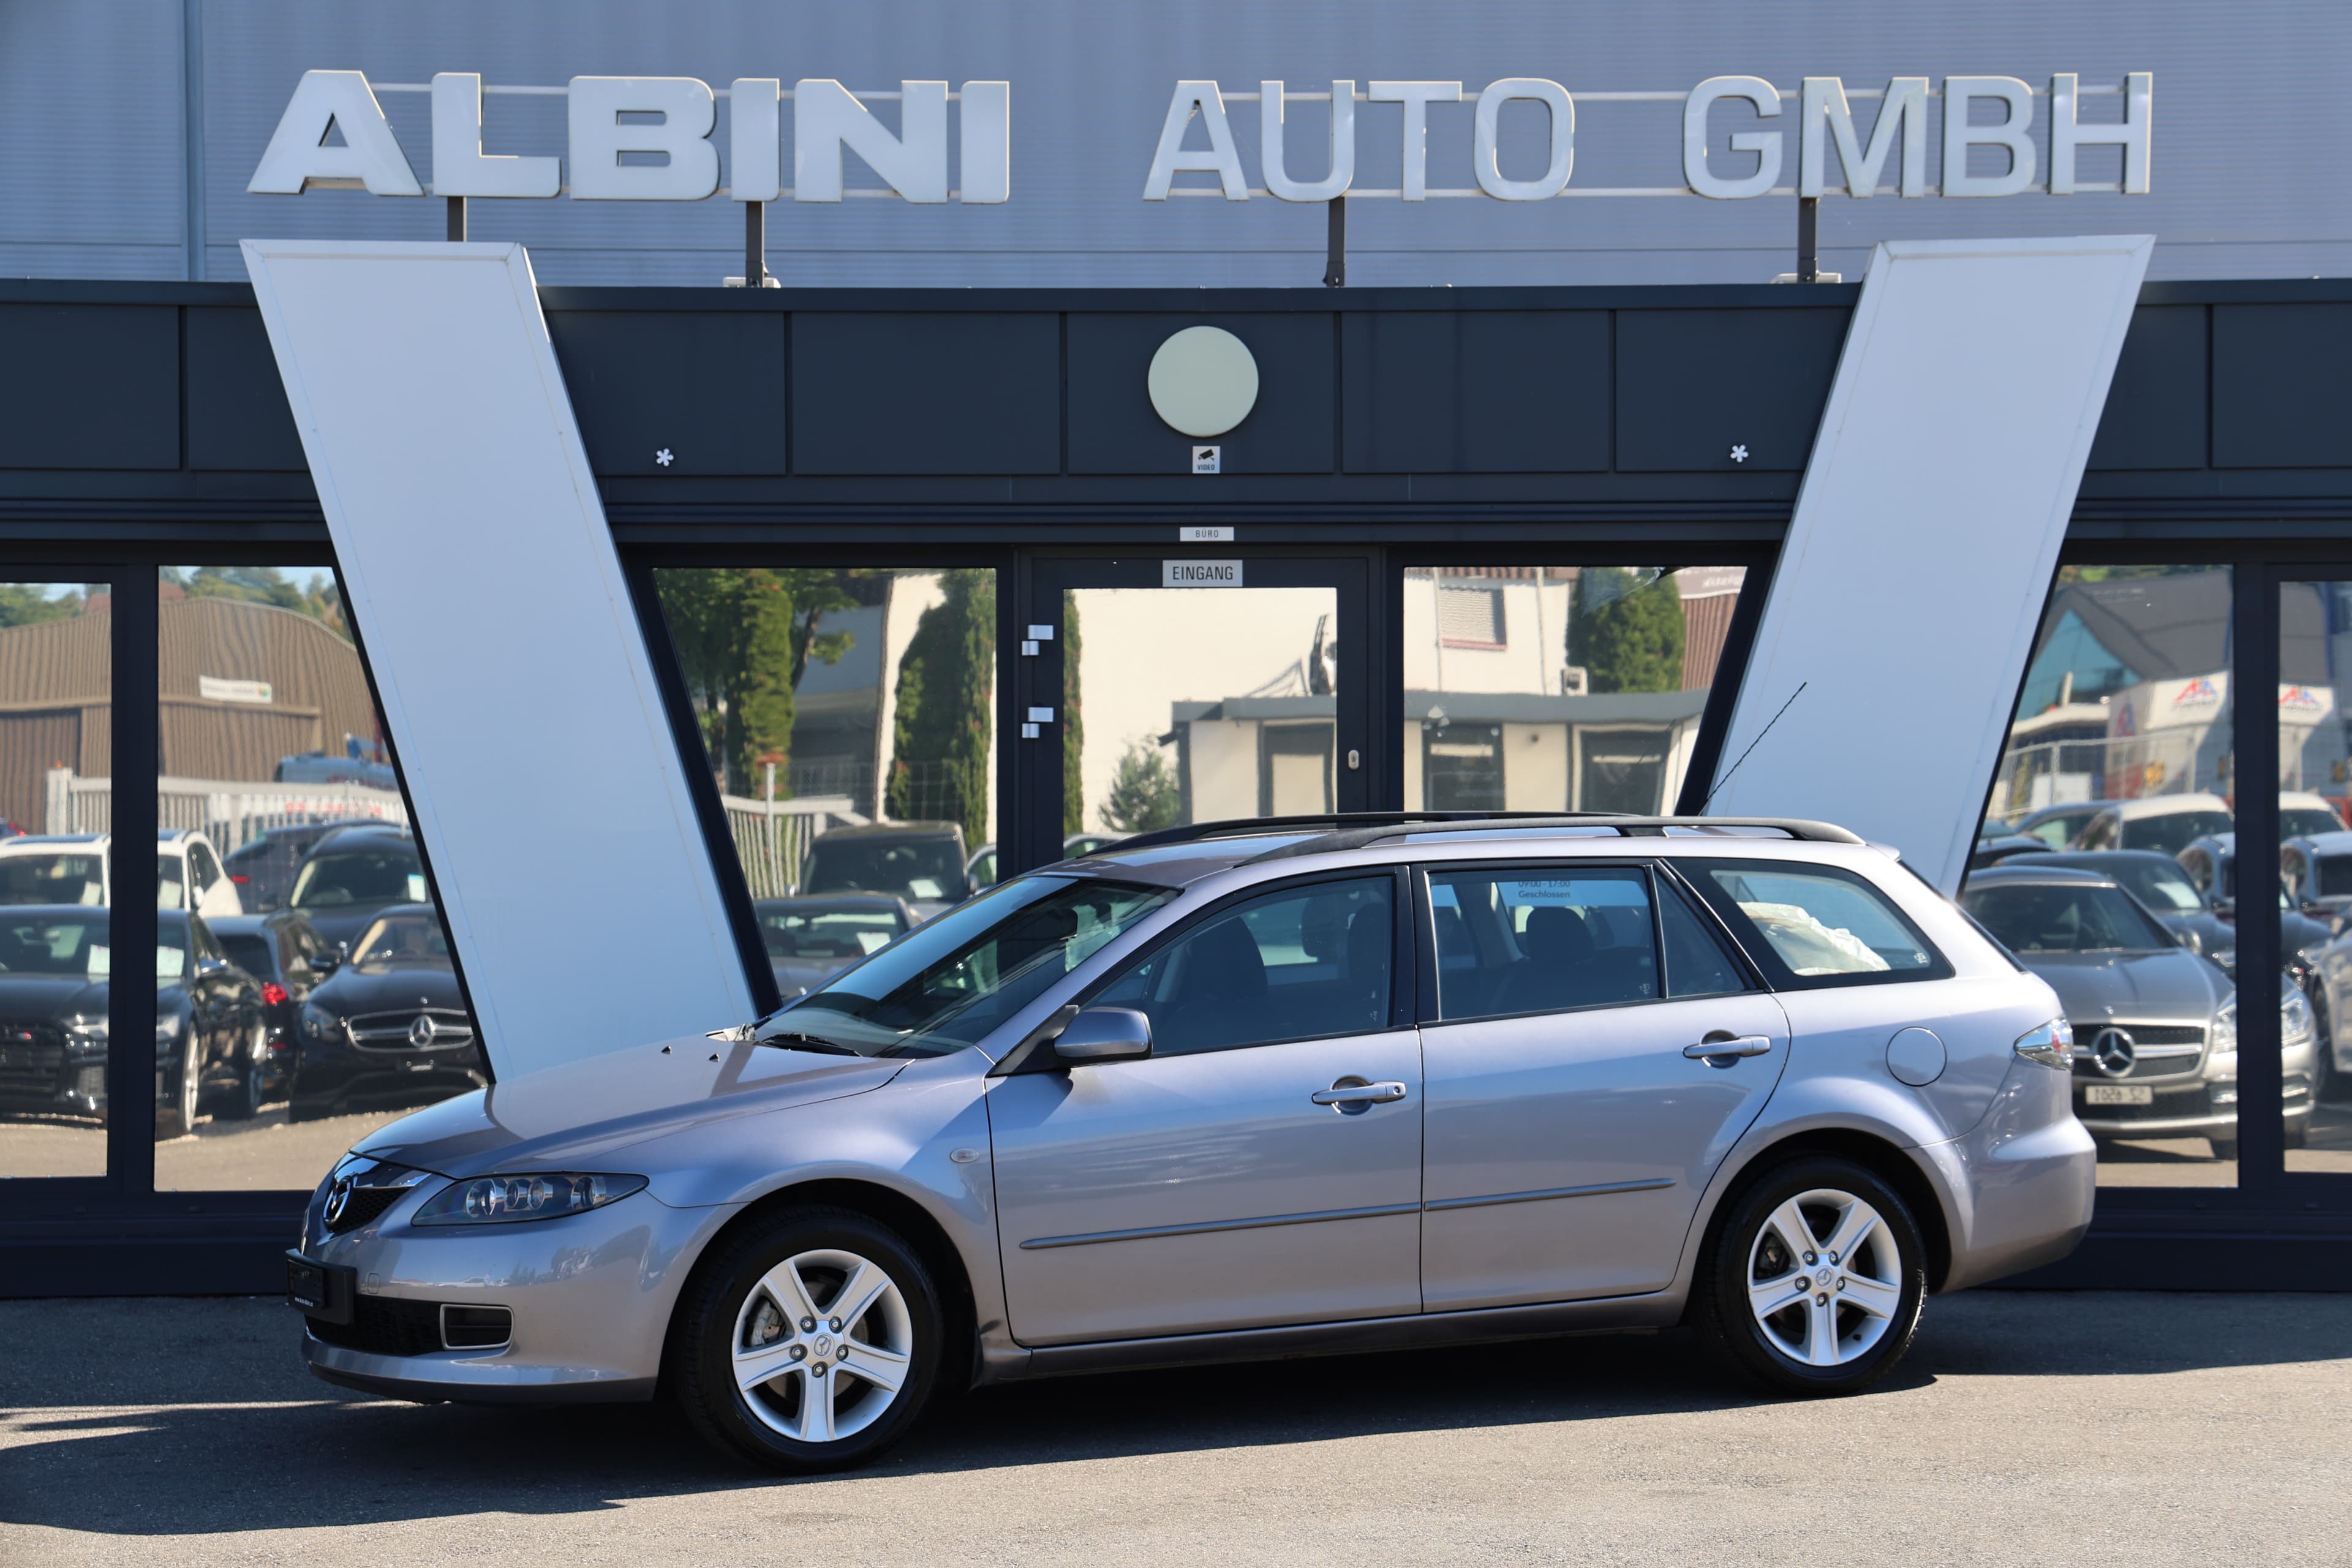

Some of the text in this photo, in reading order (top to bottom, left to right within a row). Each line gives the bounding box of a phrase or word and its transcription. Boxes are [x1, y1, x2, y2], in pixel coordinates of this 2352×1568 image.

[247, 69, 2153, 205] ALBINI AUTO GMBH
[1196, 529, 1219, 538] BÜRO
[1172, 566, 1234, 580] EINGANG
